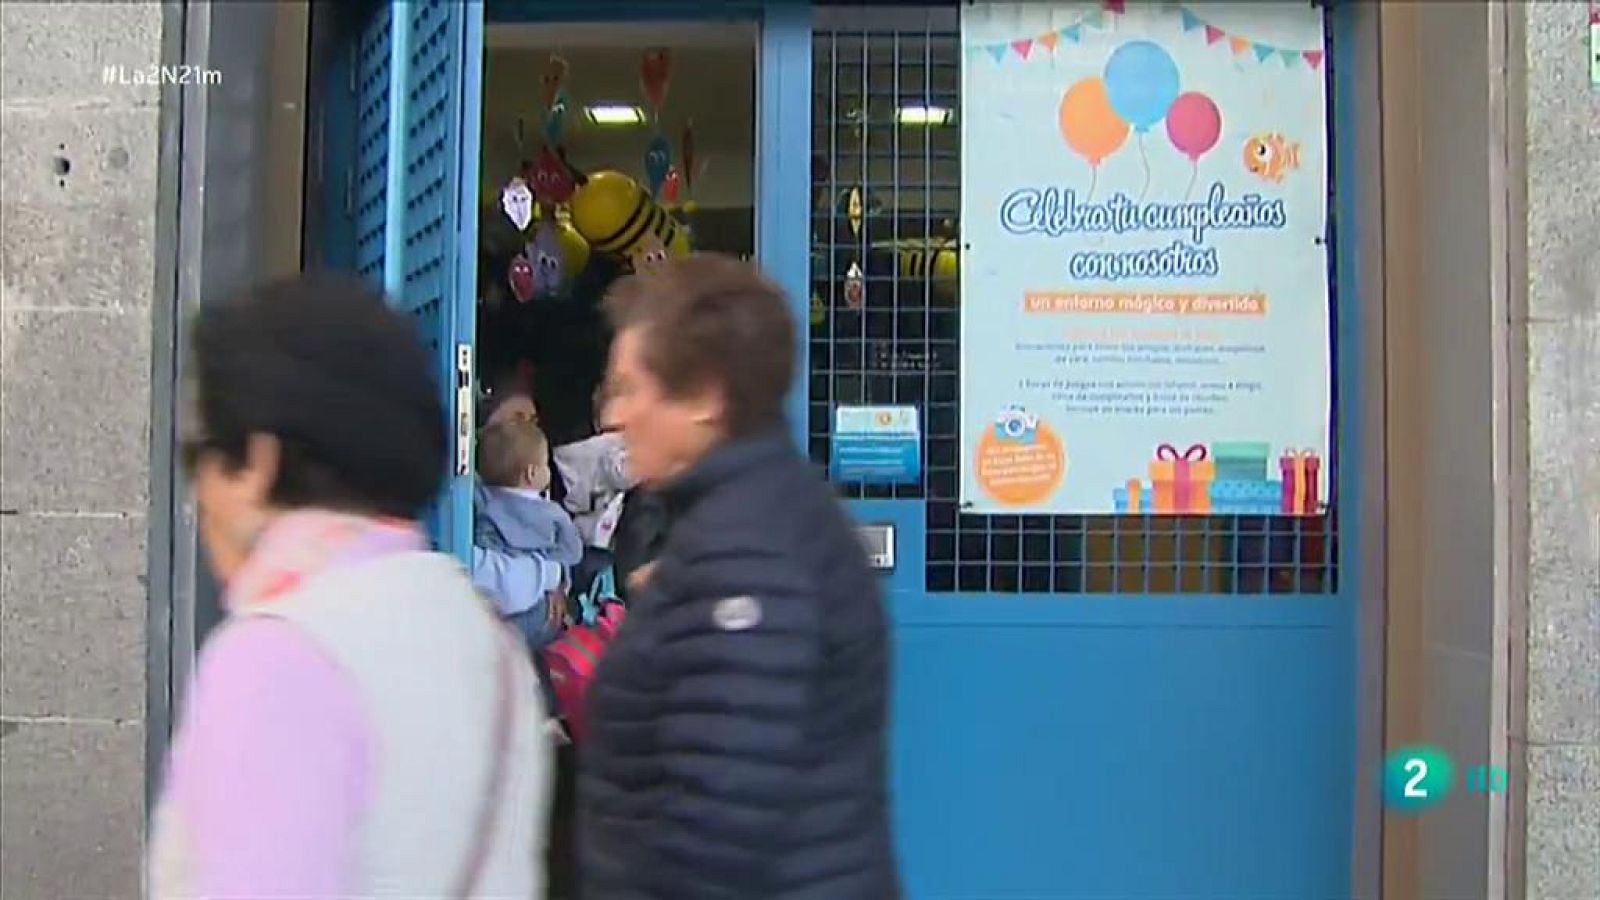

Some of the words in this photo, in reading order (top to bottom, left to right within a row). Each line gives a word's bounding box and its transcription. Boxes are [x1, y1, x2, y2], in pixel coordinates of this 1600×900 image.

[1001, 187, 1108, 236] Celebra
[1107, 192, 1141, 233] tu
[1069, 251, 1119, 280] con
[1117, 240, 1220, 279] nosotros
